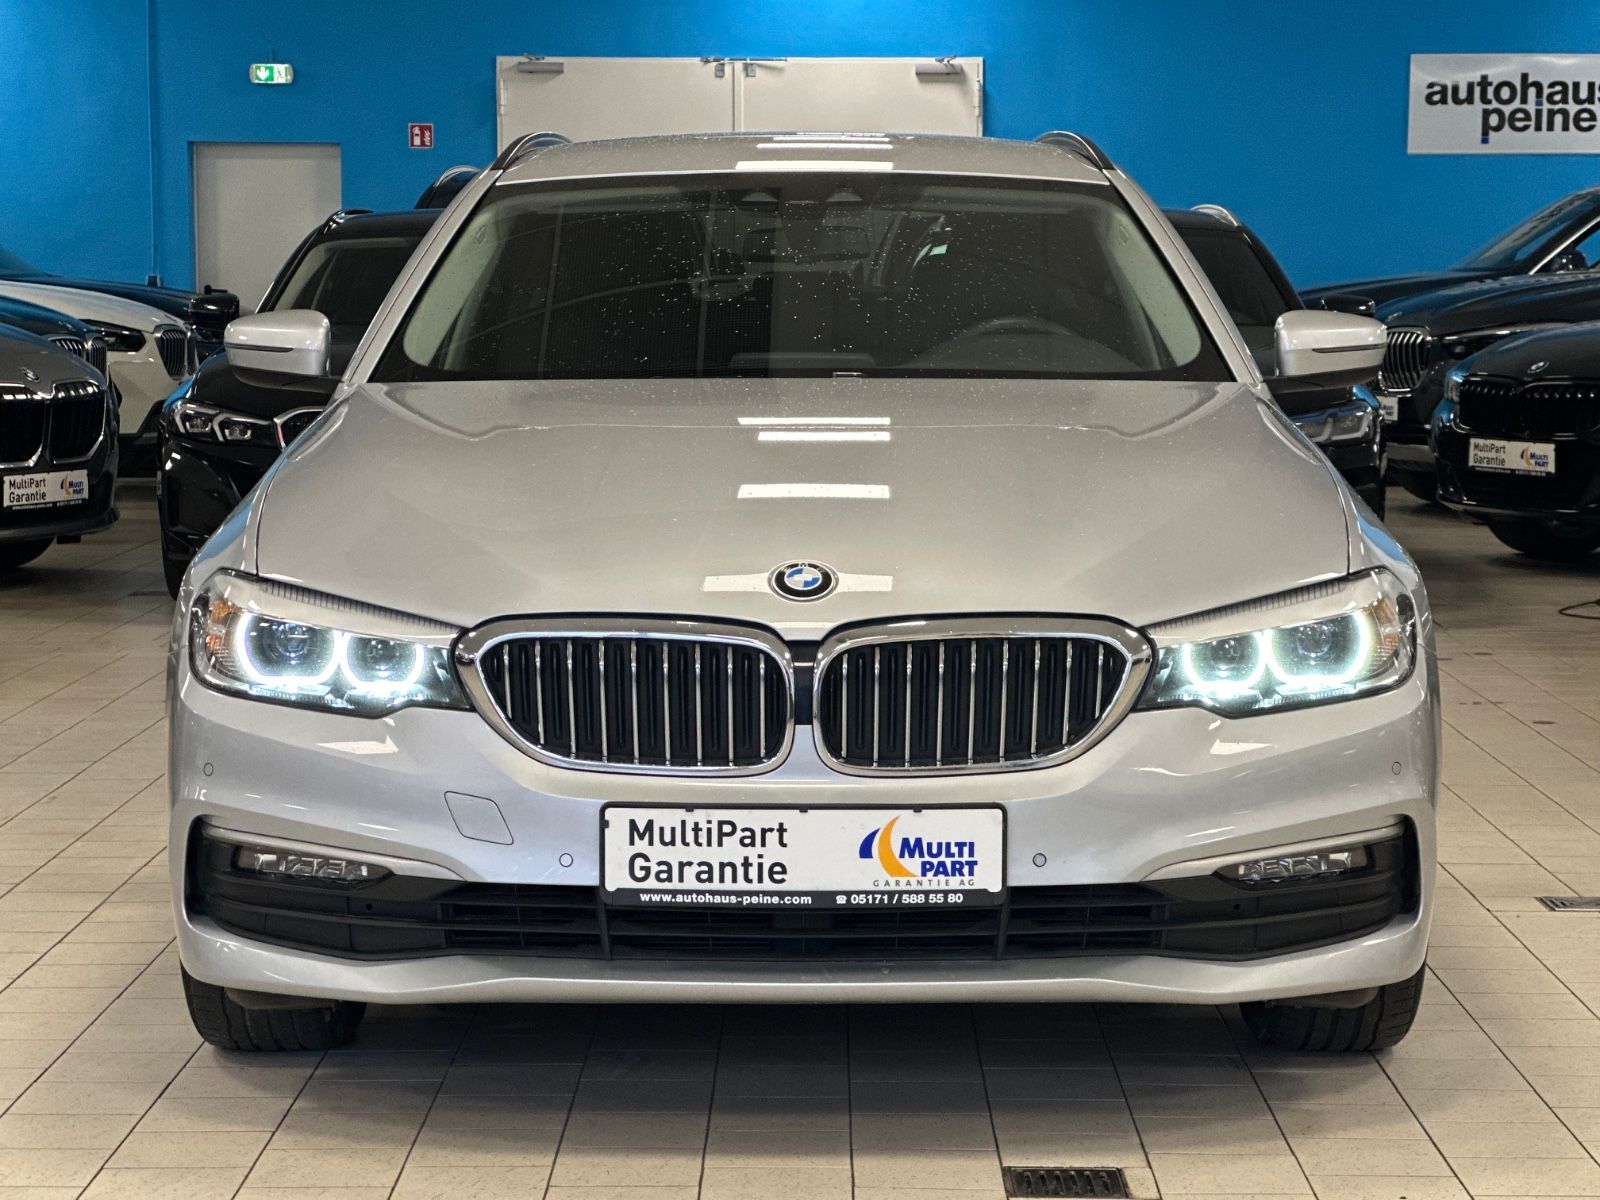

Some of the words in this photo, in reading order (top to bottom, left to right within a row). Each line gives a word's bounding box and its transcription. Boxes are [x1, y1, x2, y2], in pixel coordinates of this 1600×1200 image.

[1425, 73, 1600, 106] autohau
[1481, 99, 1597, 144] peine
[1474, 442, 1506, 454] MultiPart
[1473, 453, 1506, 467] Garantie
[9, 478, 46, 490] MultiPart
[9, 491, 47, 503] Garantie
[628, 818, 788, 848] MultiPart
[899, 837, 975, 859] MULTI
[628, 852, 788, 884] Garantie
[920, 860, 978, 877] PART
[872, 879, 951, 888] GARANTIE
[959, 878, 975, 887] AG
[639, 892, 813, 906] www.autohaus-peine.com
[850, 894, 889, 905] 05171
[901, 894, 926, 904] 588
[928, 894, 946, 904] 55
[947, 893, 964, 903] 80
